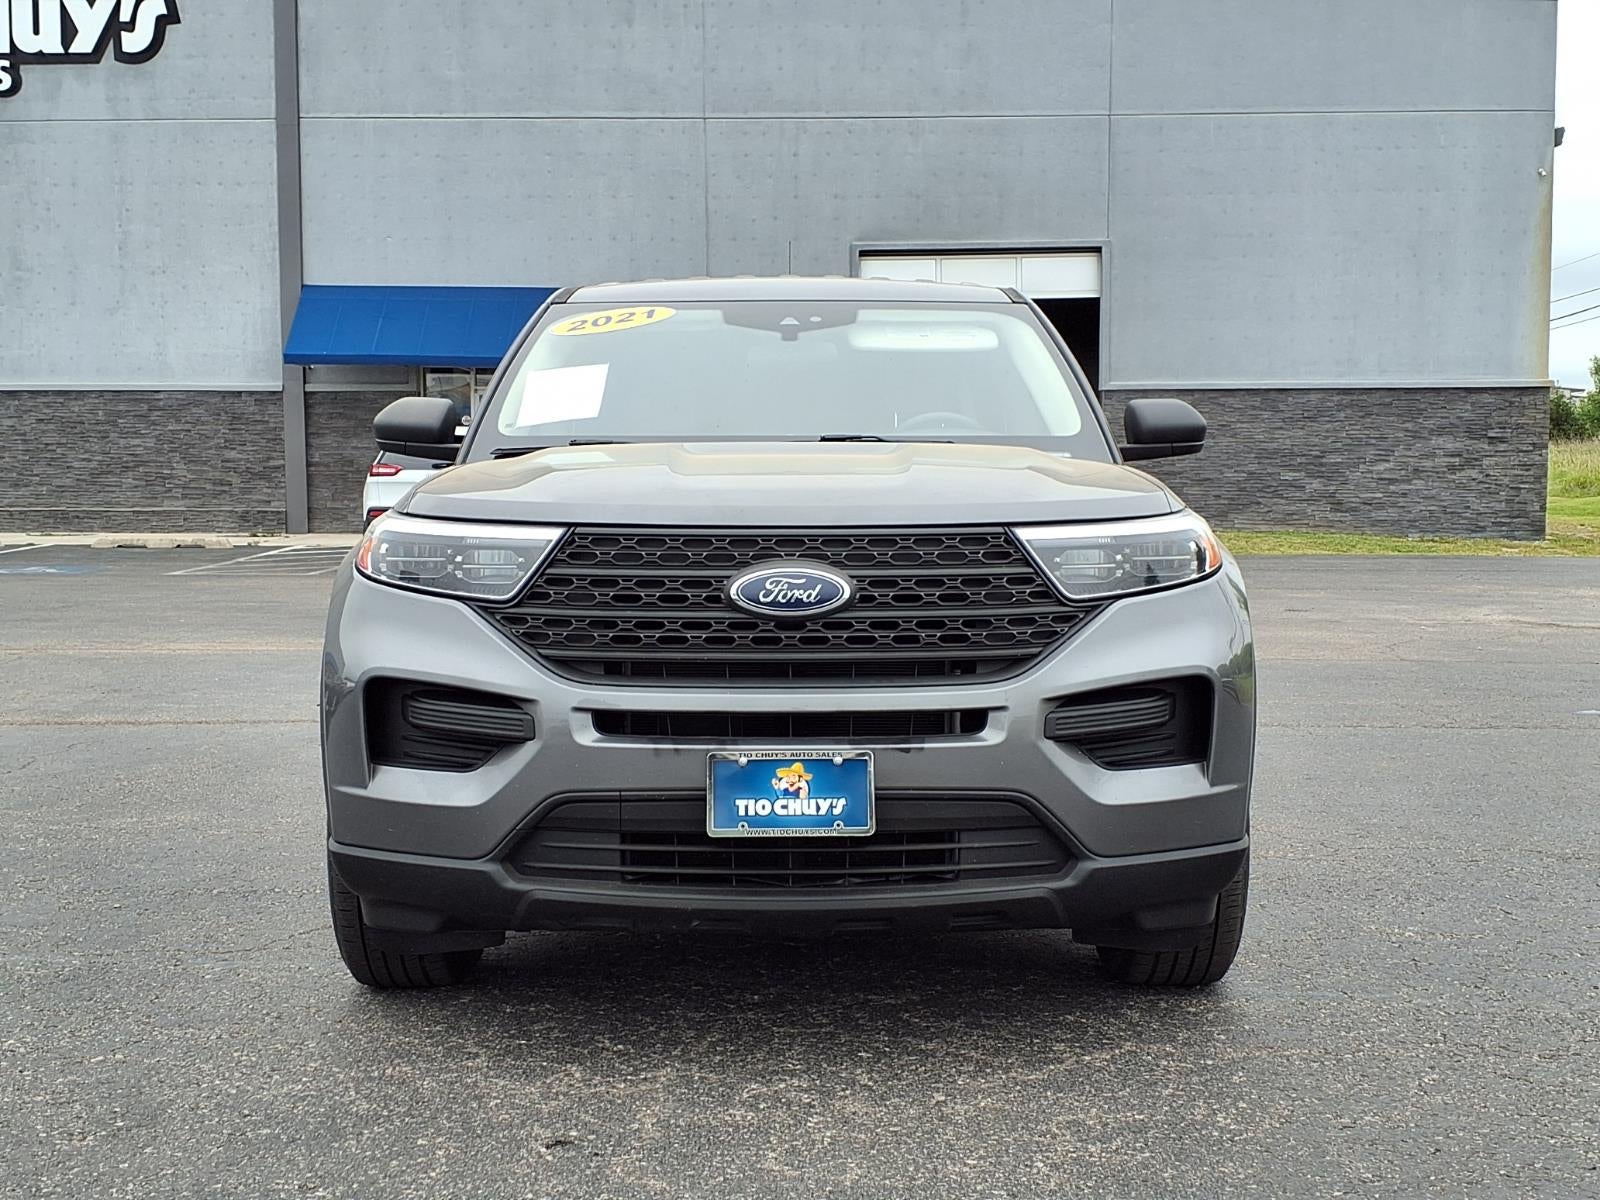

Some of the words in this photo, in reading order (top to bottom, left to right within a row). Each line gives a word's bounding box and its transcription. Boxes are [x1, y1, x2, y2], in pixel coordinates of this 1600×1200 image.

[566, 309, 656, 333] 2021
[758, 577, 822, 603] Ford
[735, 798, 772, 817] TIO
